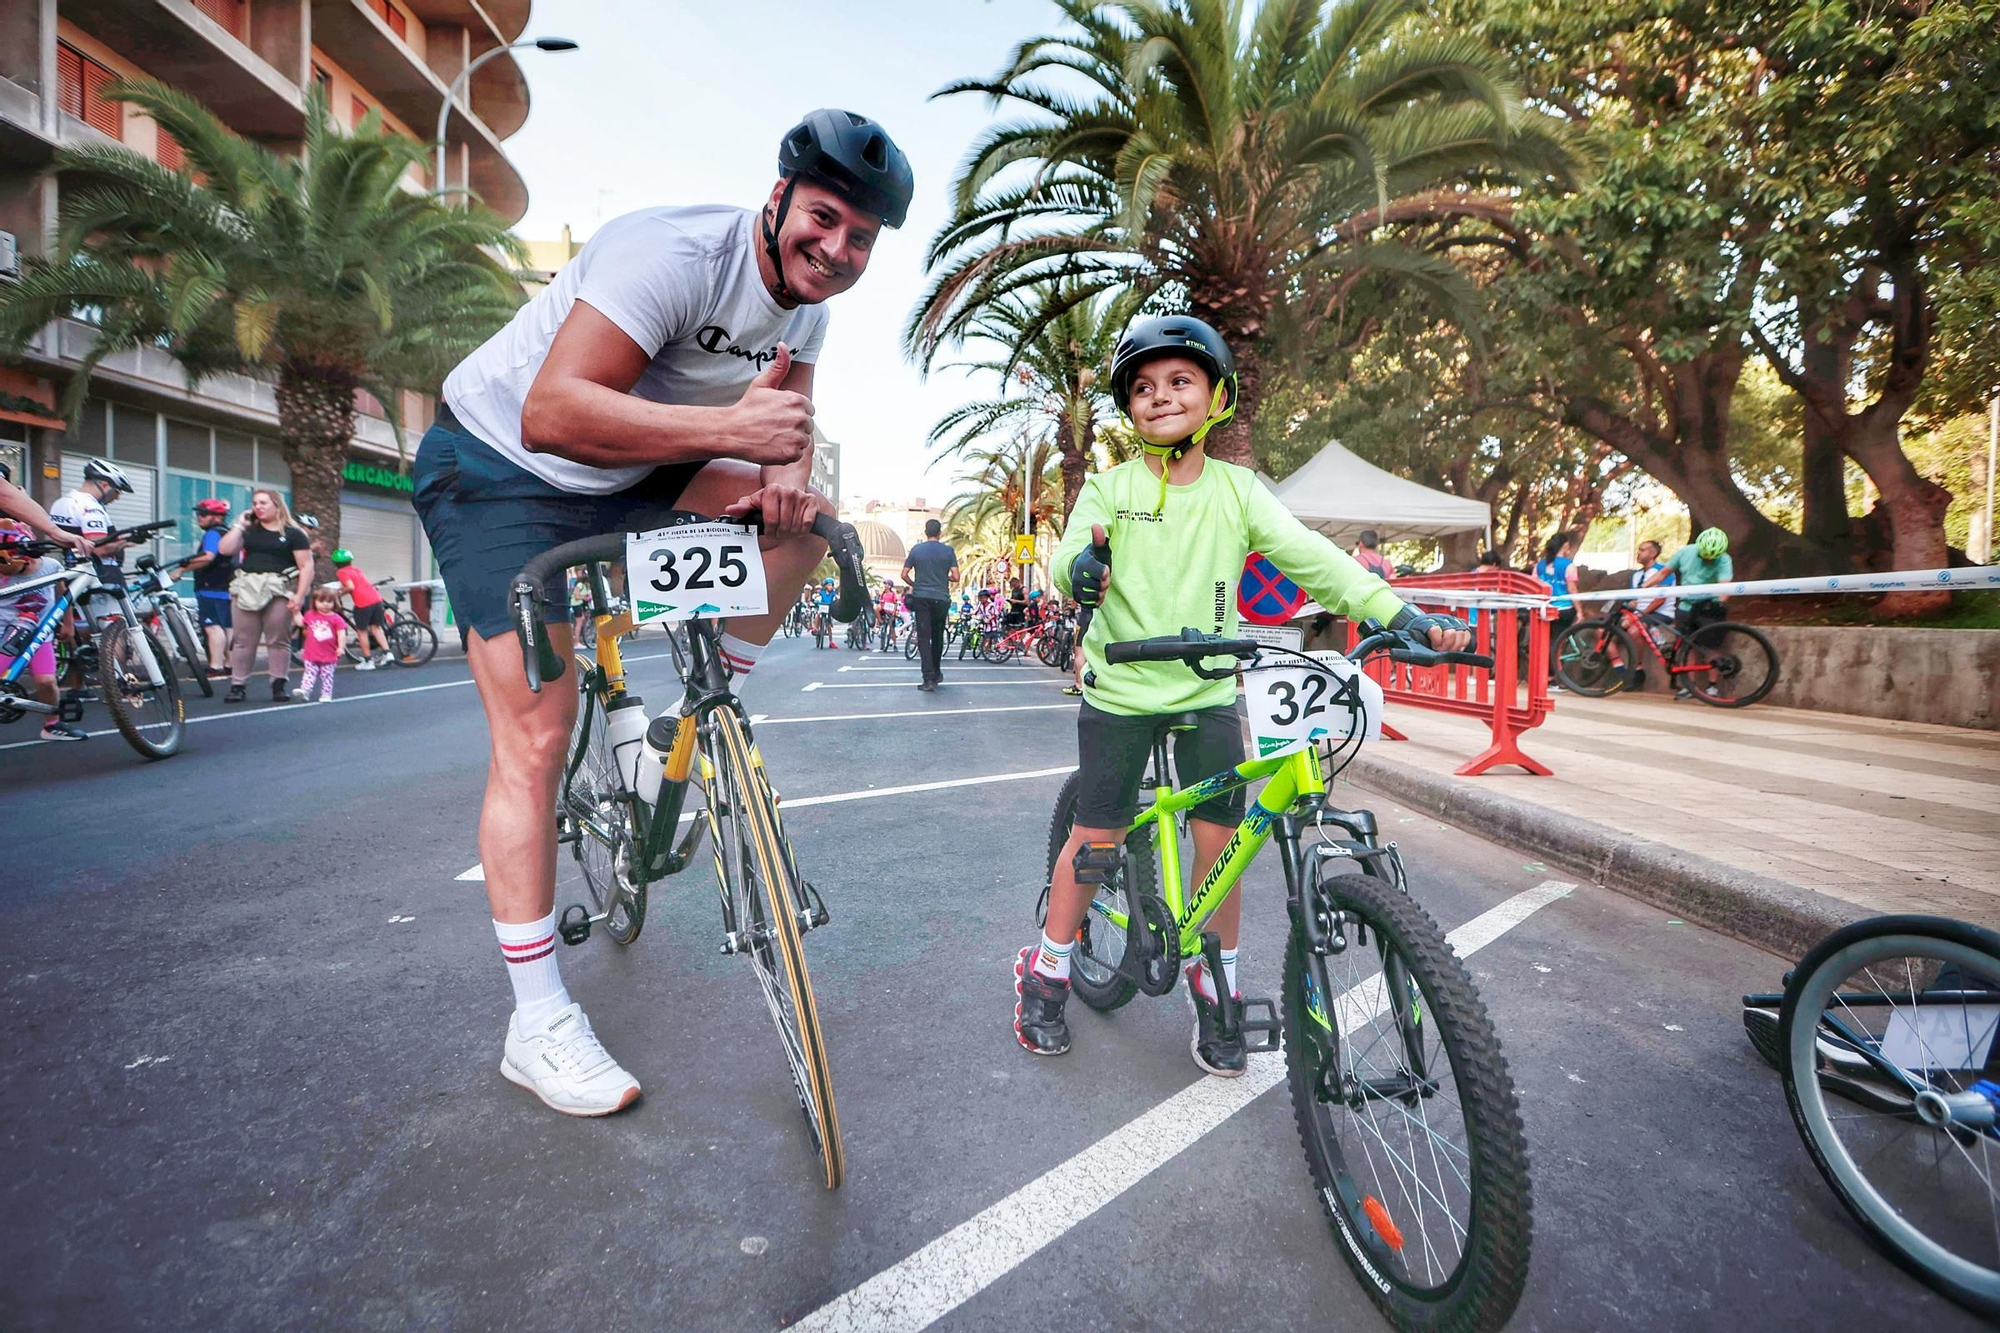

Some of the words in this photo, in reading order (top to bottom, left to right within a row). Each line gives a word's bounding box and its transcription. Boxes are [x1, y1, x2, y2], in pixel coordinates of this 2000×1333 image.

[649, 546, 748, 592] 325
[1215, 581, 1226, 622] HORIZONS
[1268, 674, 1362, 725] 324
[1177, 831, 1242, 935] ROCKRIDER
[549, 1014, 572, 1031] Reebok
[541, 1053, 559, 1072] Reebok
